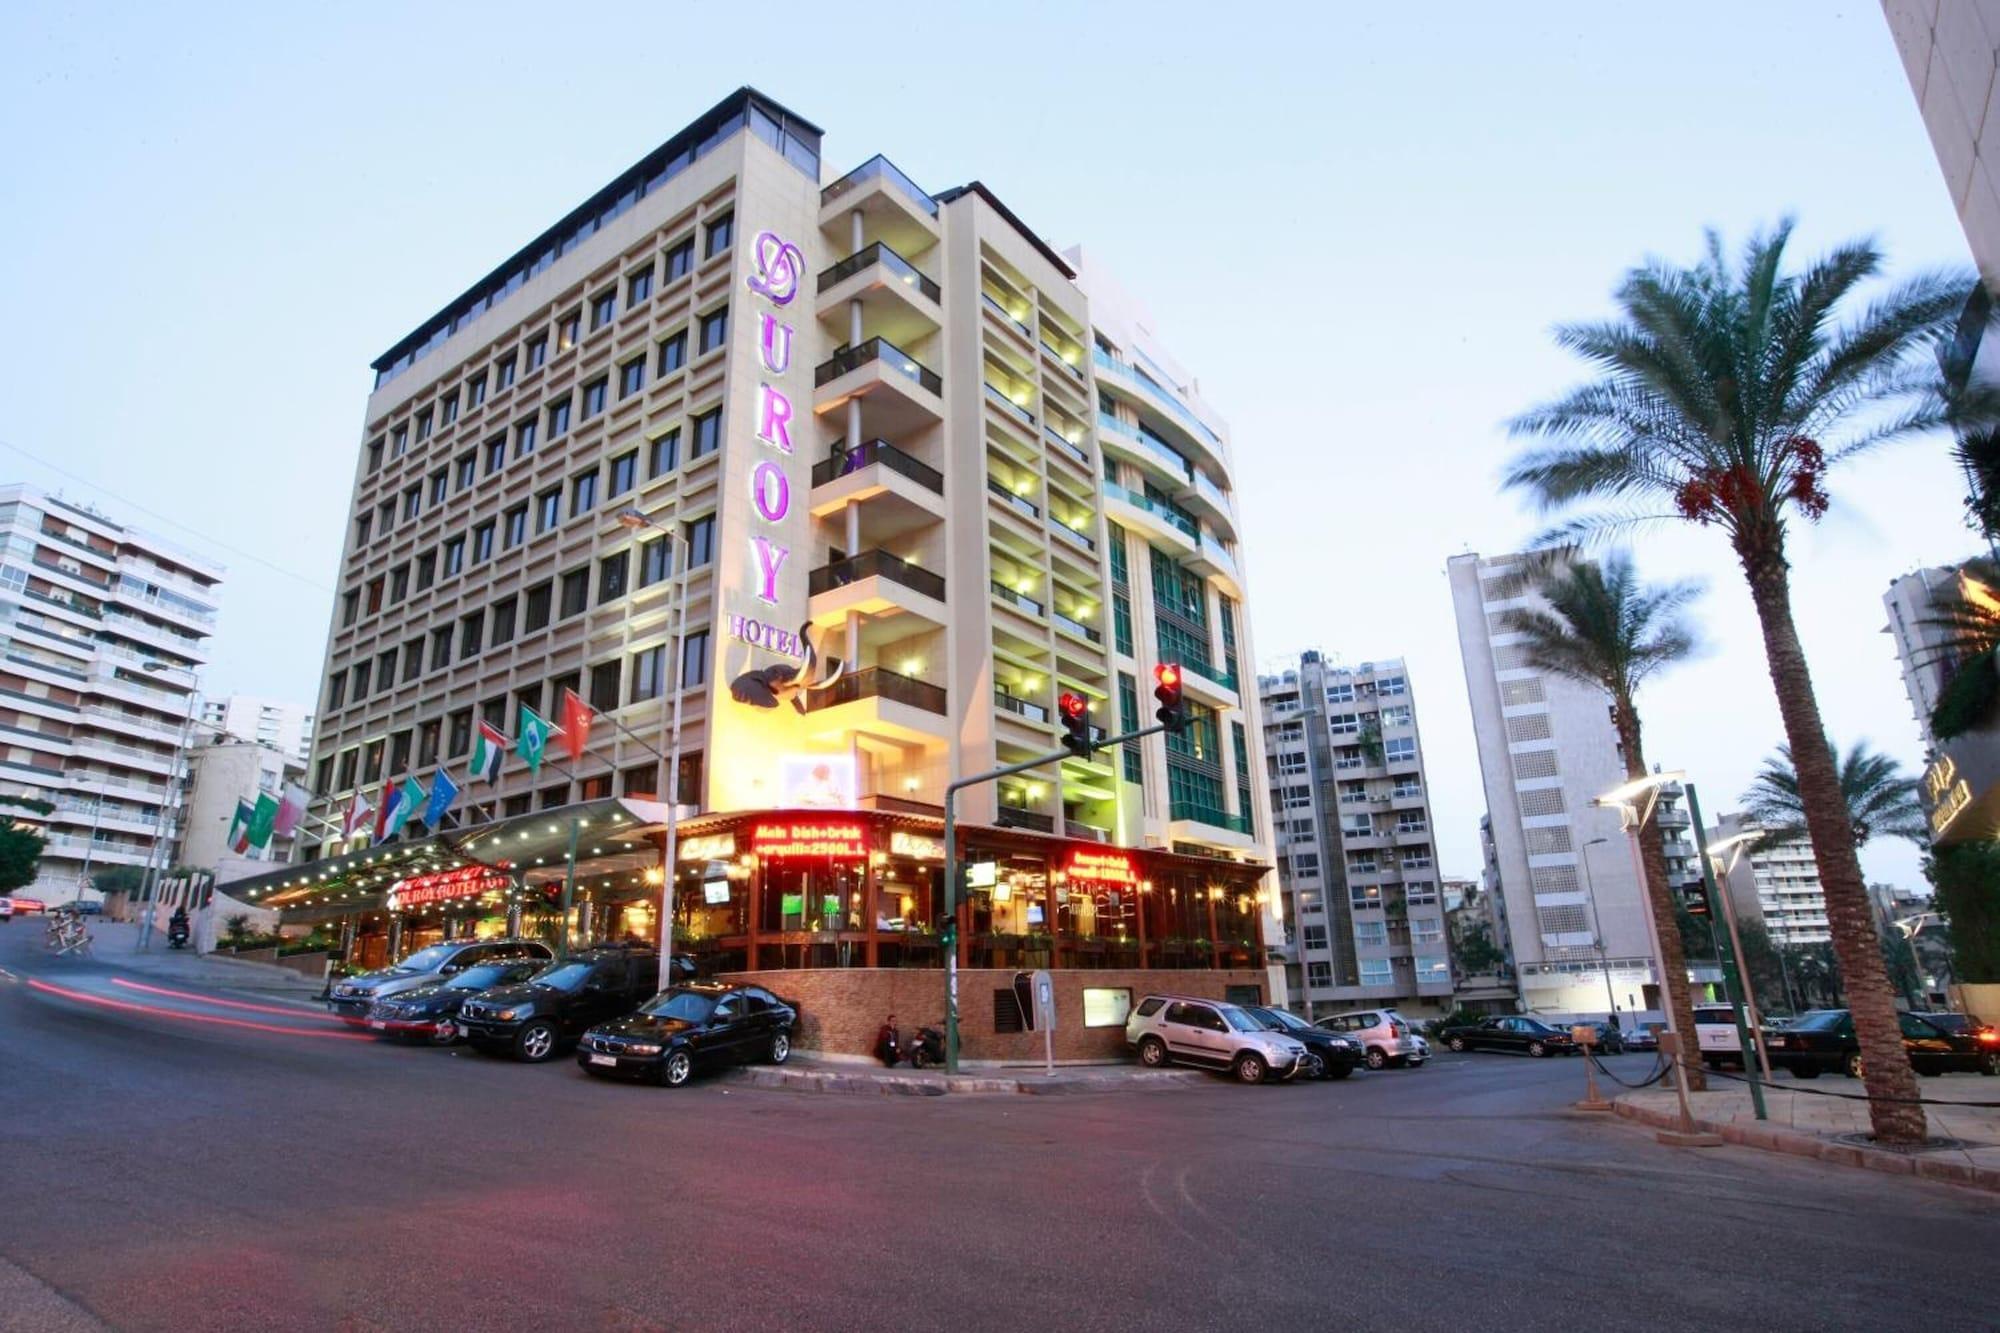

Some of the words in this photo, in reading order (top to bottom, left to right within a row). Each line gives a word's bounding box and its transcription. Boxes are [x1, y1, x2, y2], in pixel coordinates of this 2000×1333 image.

[746, 232, 806, 606] DUROY
[729, 613, 804, 658] HOTEL
[756, 824, 787, 839] Main
